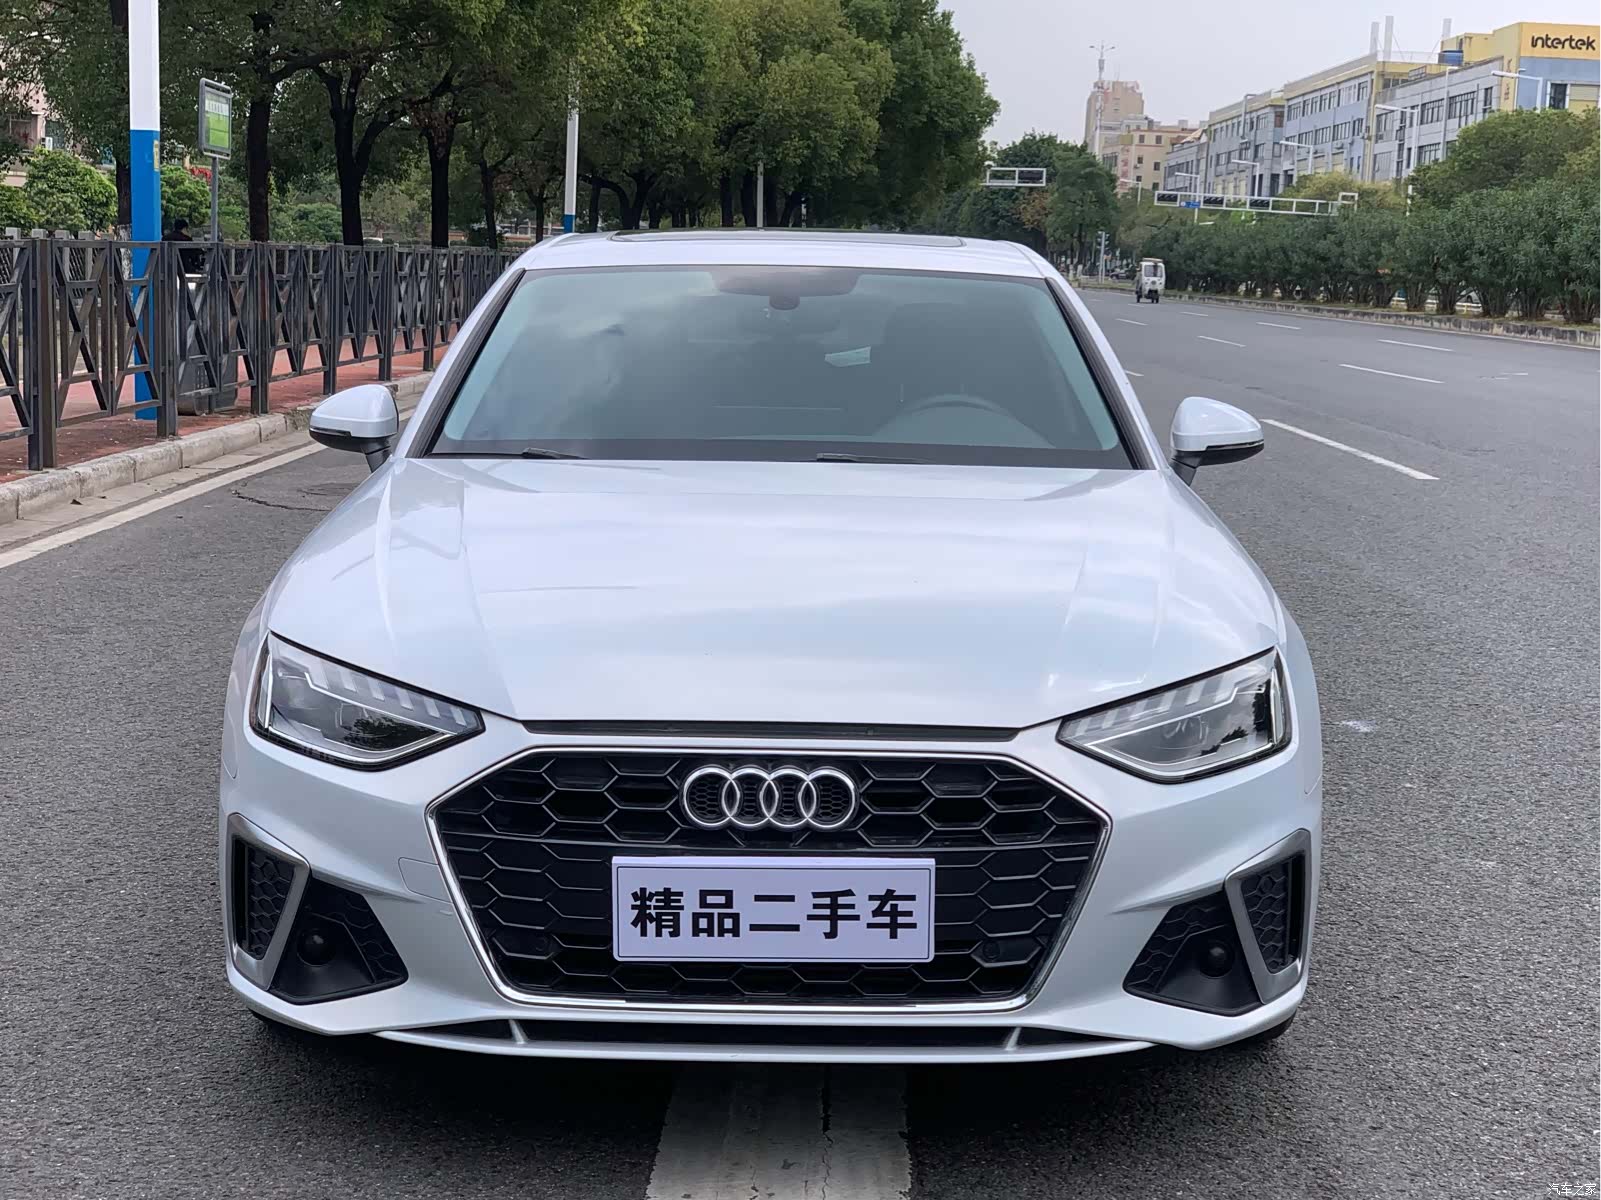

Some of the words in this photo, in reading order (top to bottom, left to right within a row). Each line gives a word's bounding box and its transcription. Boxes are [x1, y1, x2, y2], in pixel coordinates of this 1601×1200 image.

[1531, 34, 1596, 51] intertek
[630, 887, 918, 939] 精品二手车
